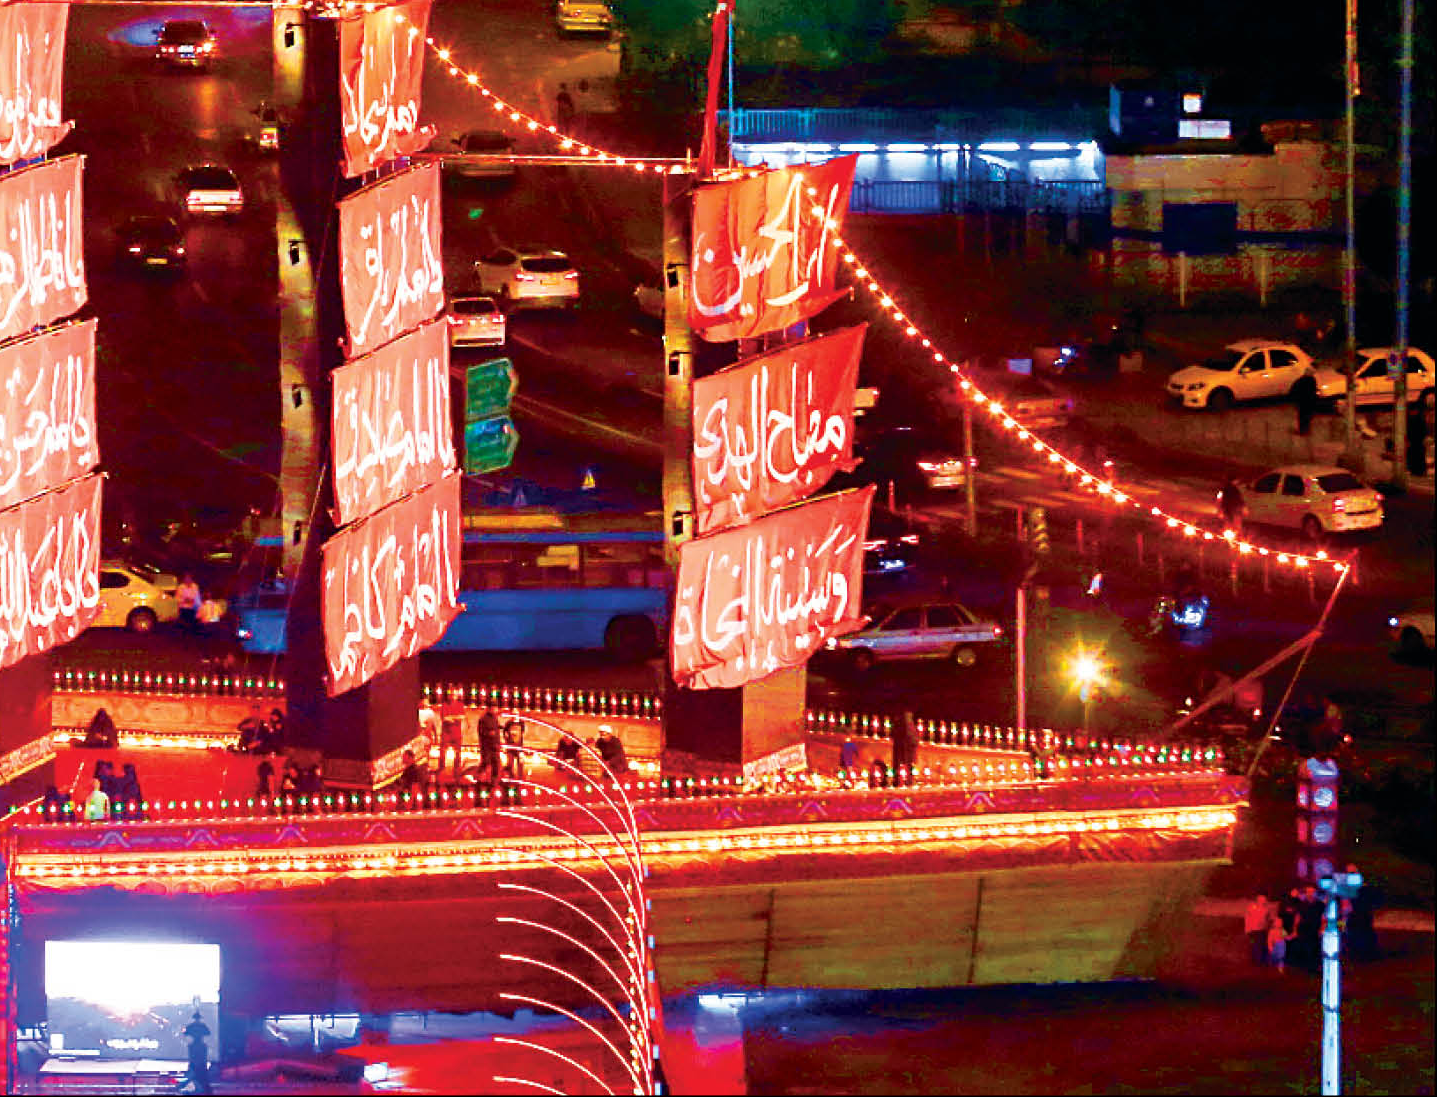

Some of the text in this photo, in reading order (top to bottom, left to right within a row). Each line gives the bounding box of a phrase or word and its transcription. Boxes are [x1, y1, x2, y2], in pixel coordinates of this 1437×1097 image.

[692, 172, 804, 316] الحسین
[694, 362, 847, 491] مصباح الهدی
